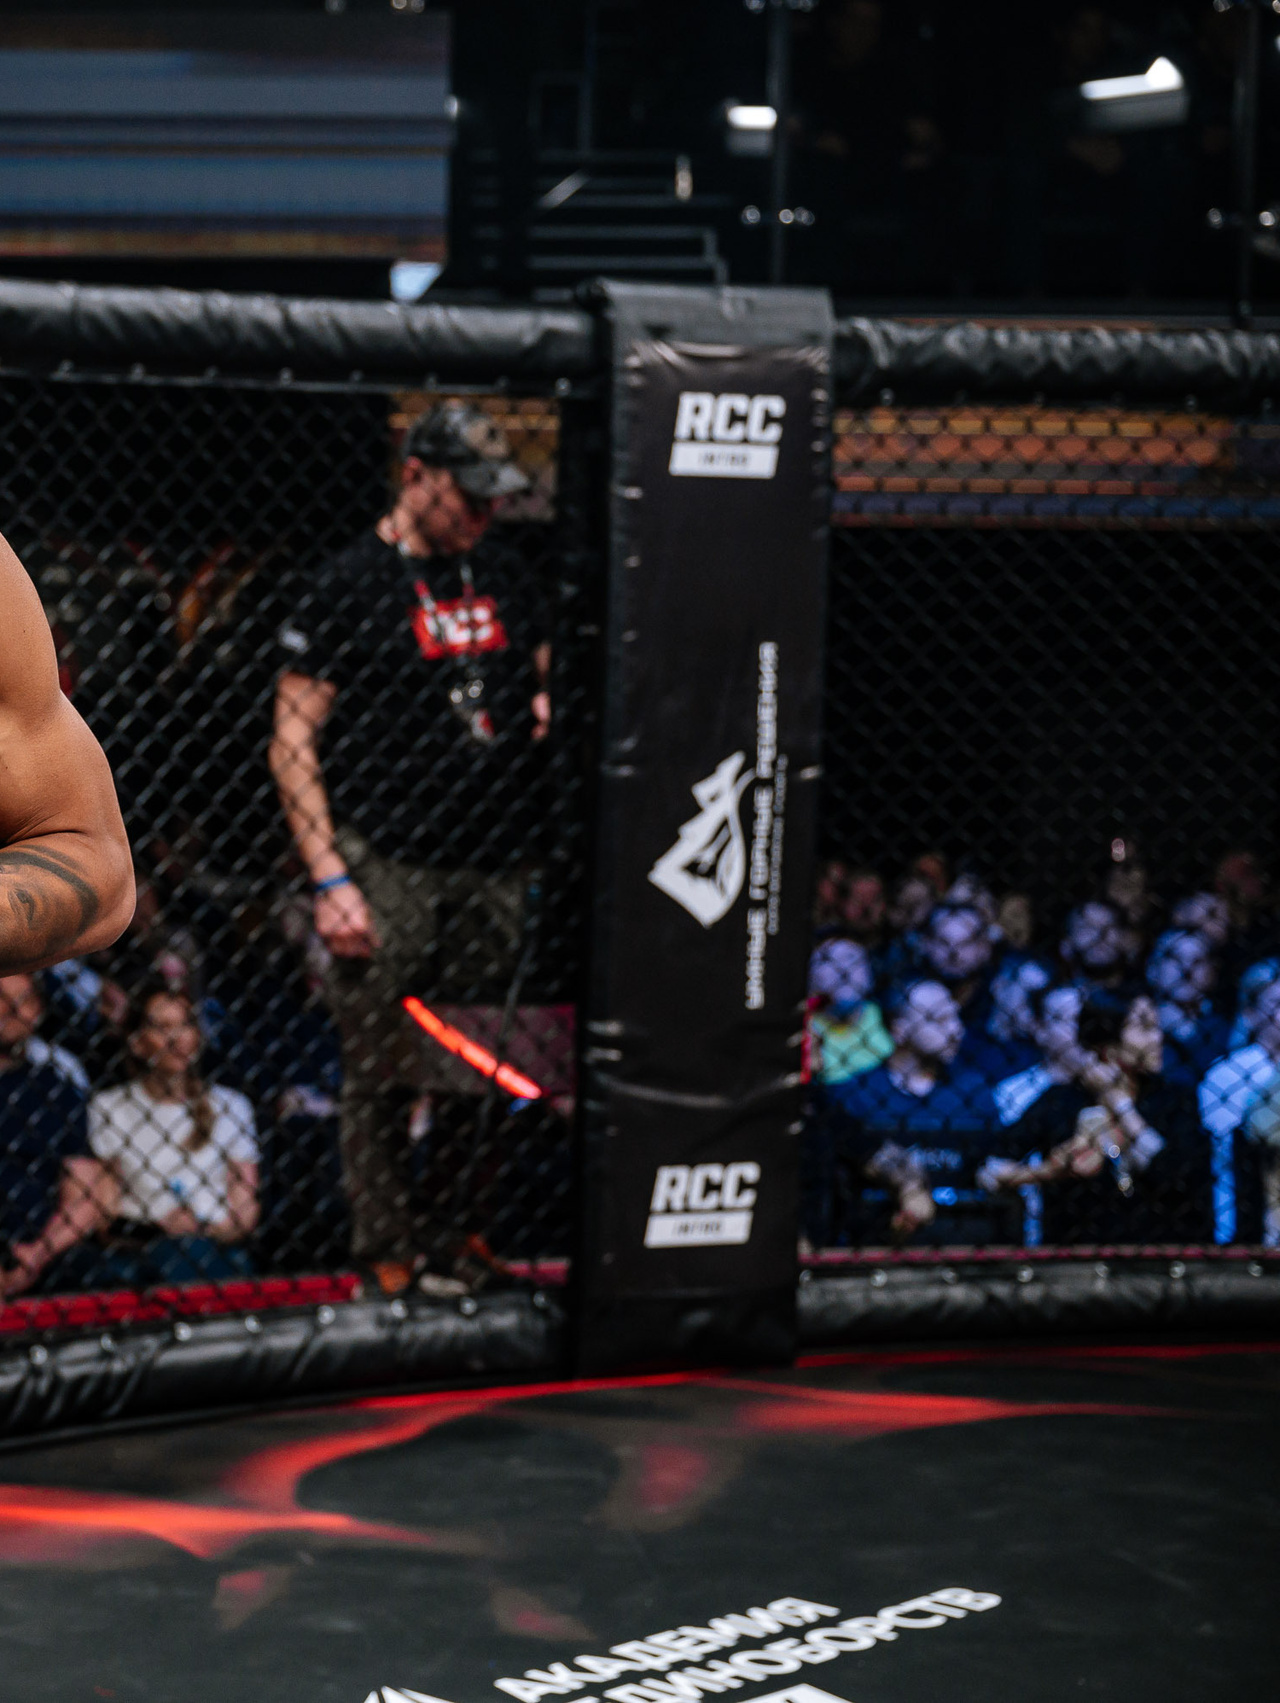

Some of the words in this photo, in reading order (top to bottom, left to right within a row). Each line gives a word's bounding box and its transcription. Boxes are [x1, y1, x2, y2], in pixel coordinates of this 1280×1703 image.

[674, 391, 787, 443] RCC
[650, 1161, 761, 1212] RCC
[494, 1597, 841, 1703] АКАДЕМИЯ
